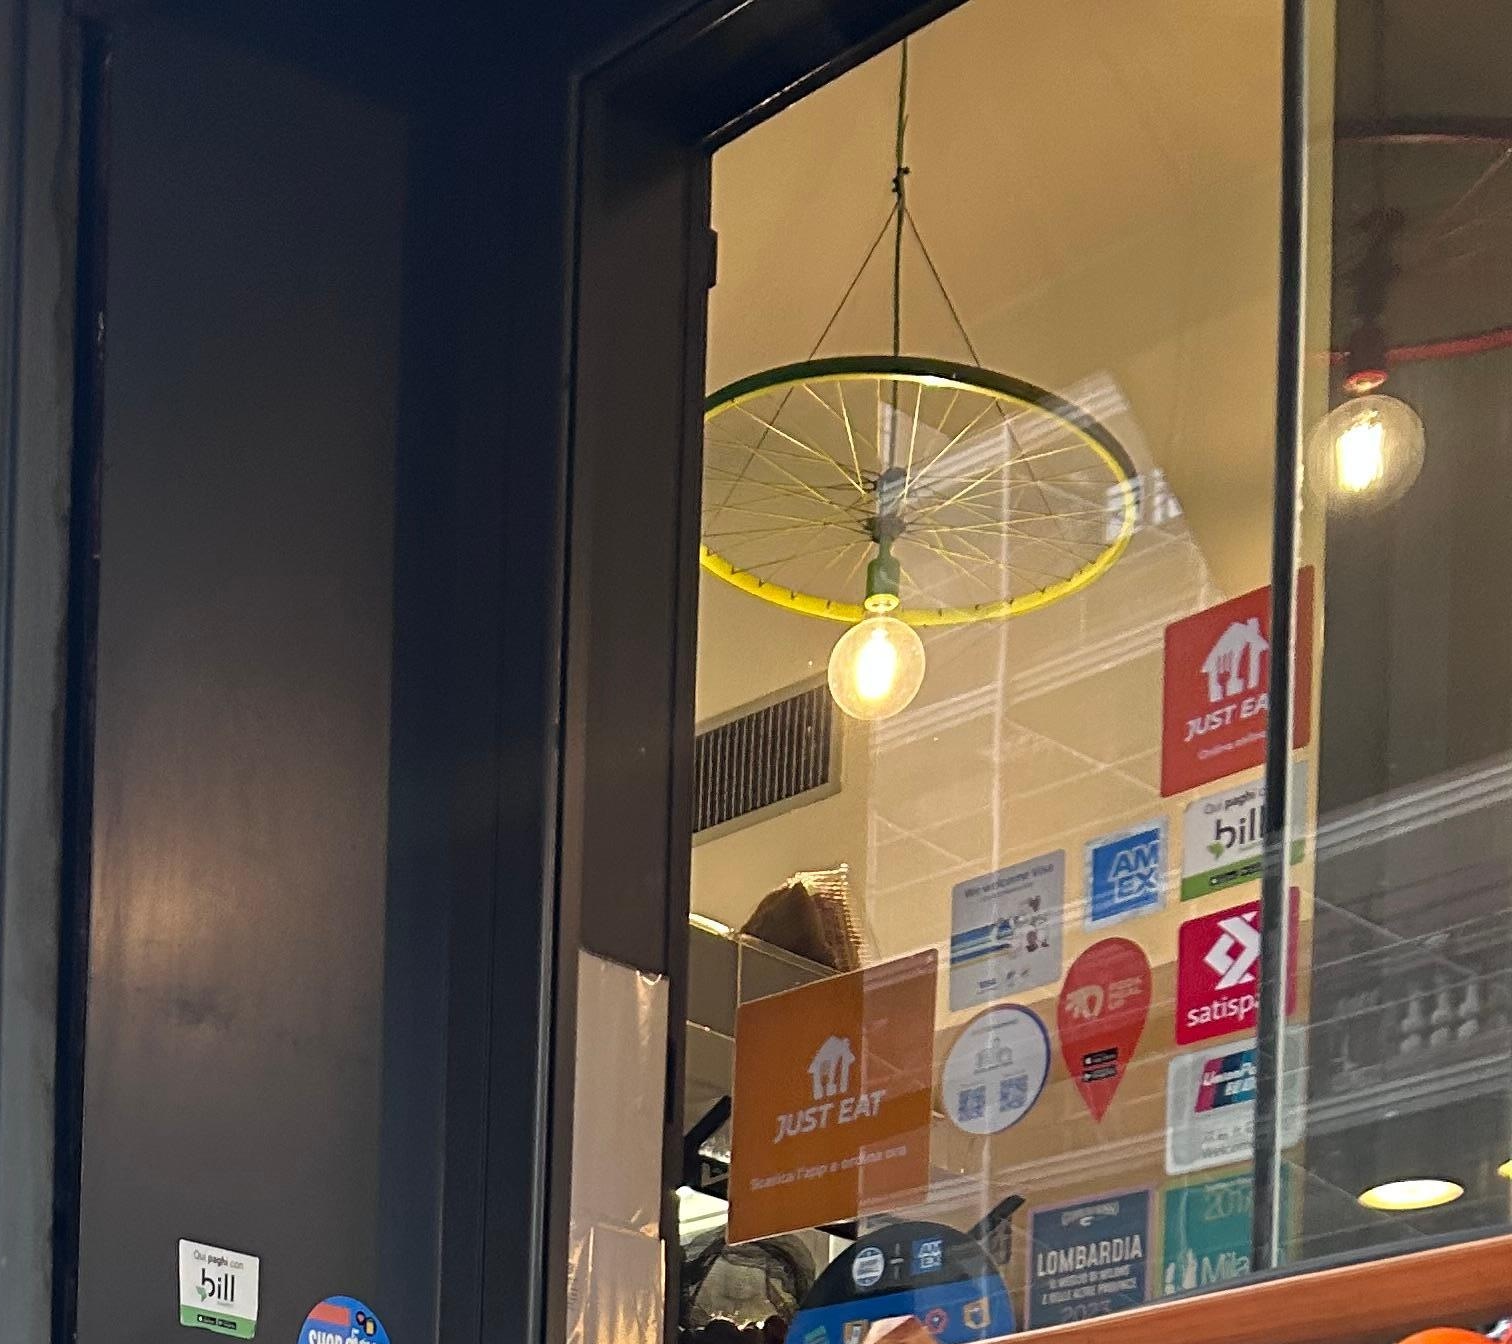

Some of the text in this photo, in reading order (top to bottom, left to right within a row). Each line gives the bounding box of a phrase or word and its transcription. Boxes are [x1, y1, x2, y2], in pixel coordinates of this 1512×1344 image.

[1184, 693, 1269, 742] JUST EA
[772, 1088, 886, 1145] JUST EAT
[1038, 1234, 1143, 1277] LOMBARDIA
[200, 1267, 235, 1302] bill
